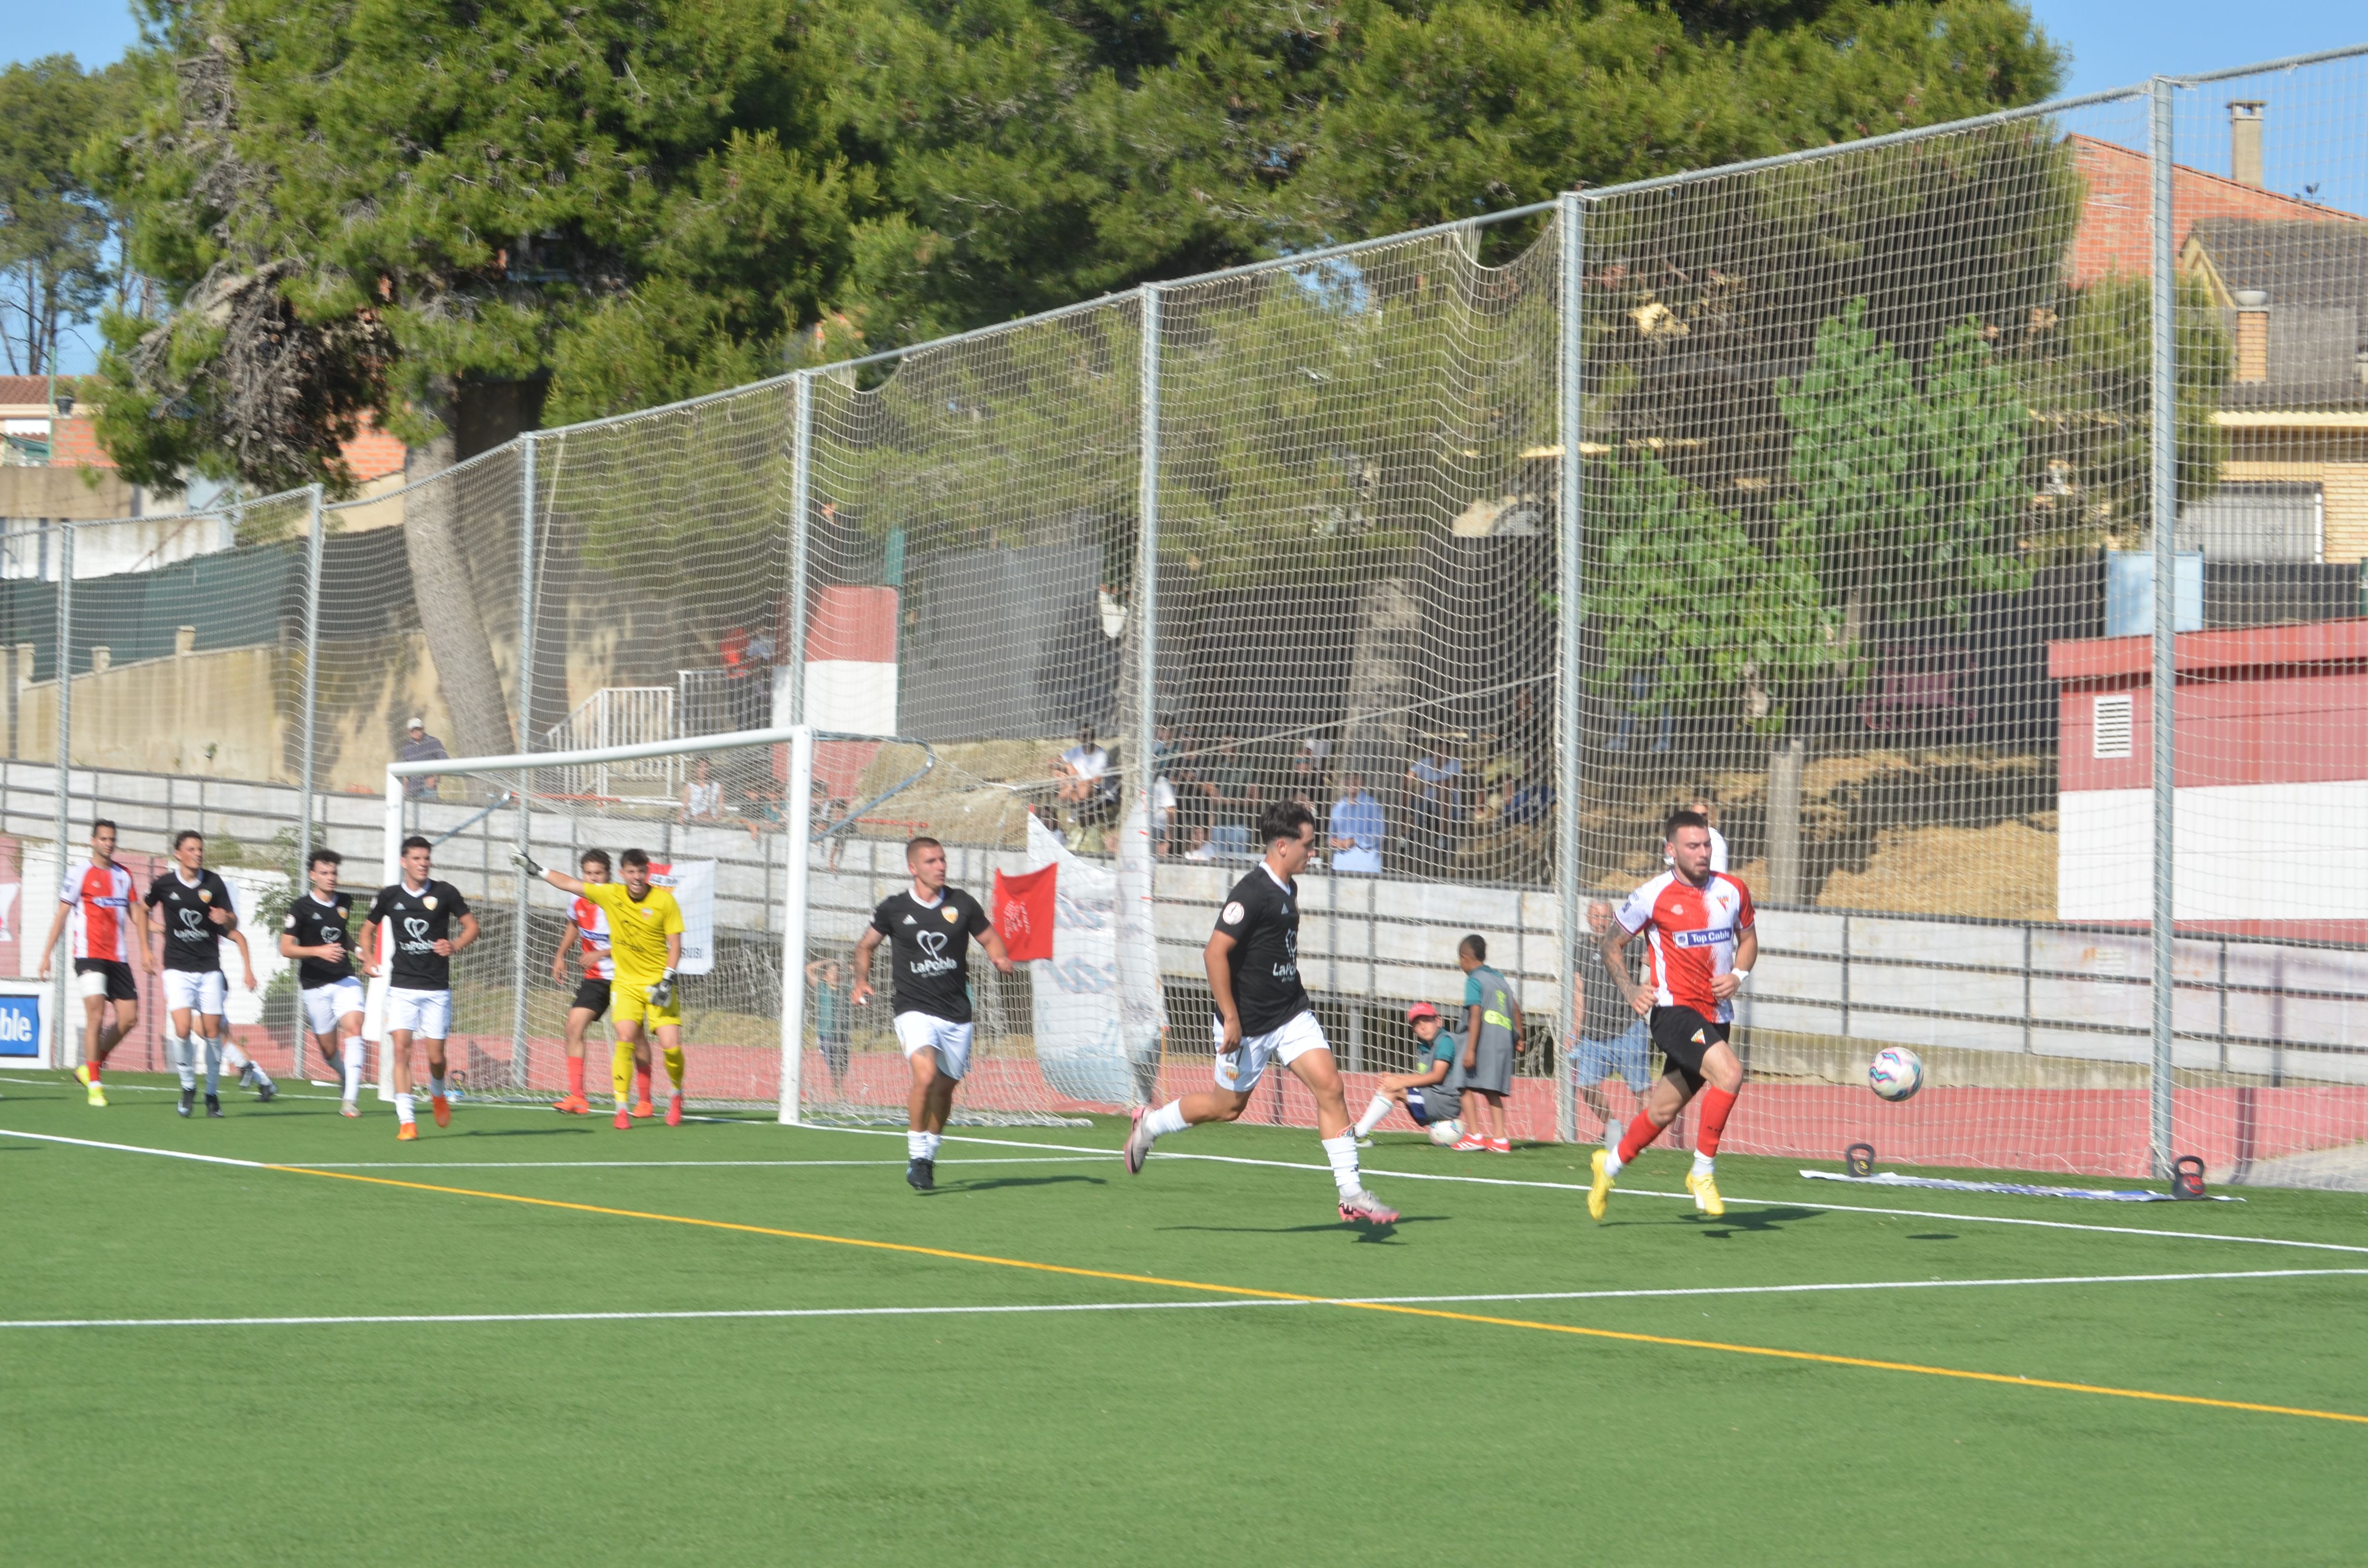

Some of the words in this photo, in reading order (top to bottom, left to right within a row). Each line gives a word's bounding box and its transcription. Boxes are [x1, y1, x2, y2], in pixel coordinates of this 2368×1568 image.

[1690, 933, 1707, 944] Top
[1708, 930, 1730, 942] Cable
[399, 939, 435, 951] LaPobl
[910, 956, 957, 973] LaPobla
[1273, 962, 1296, 976] LaPo
[0, 1007, 33, 1042] ble
